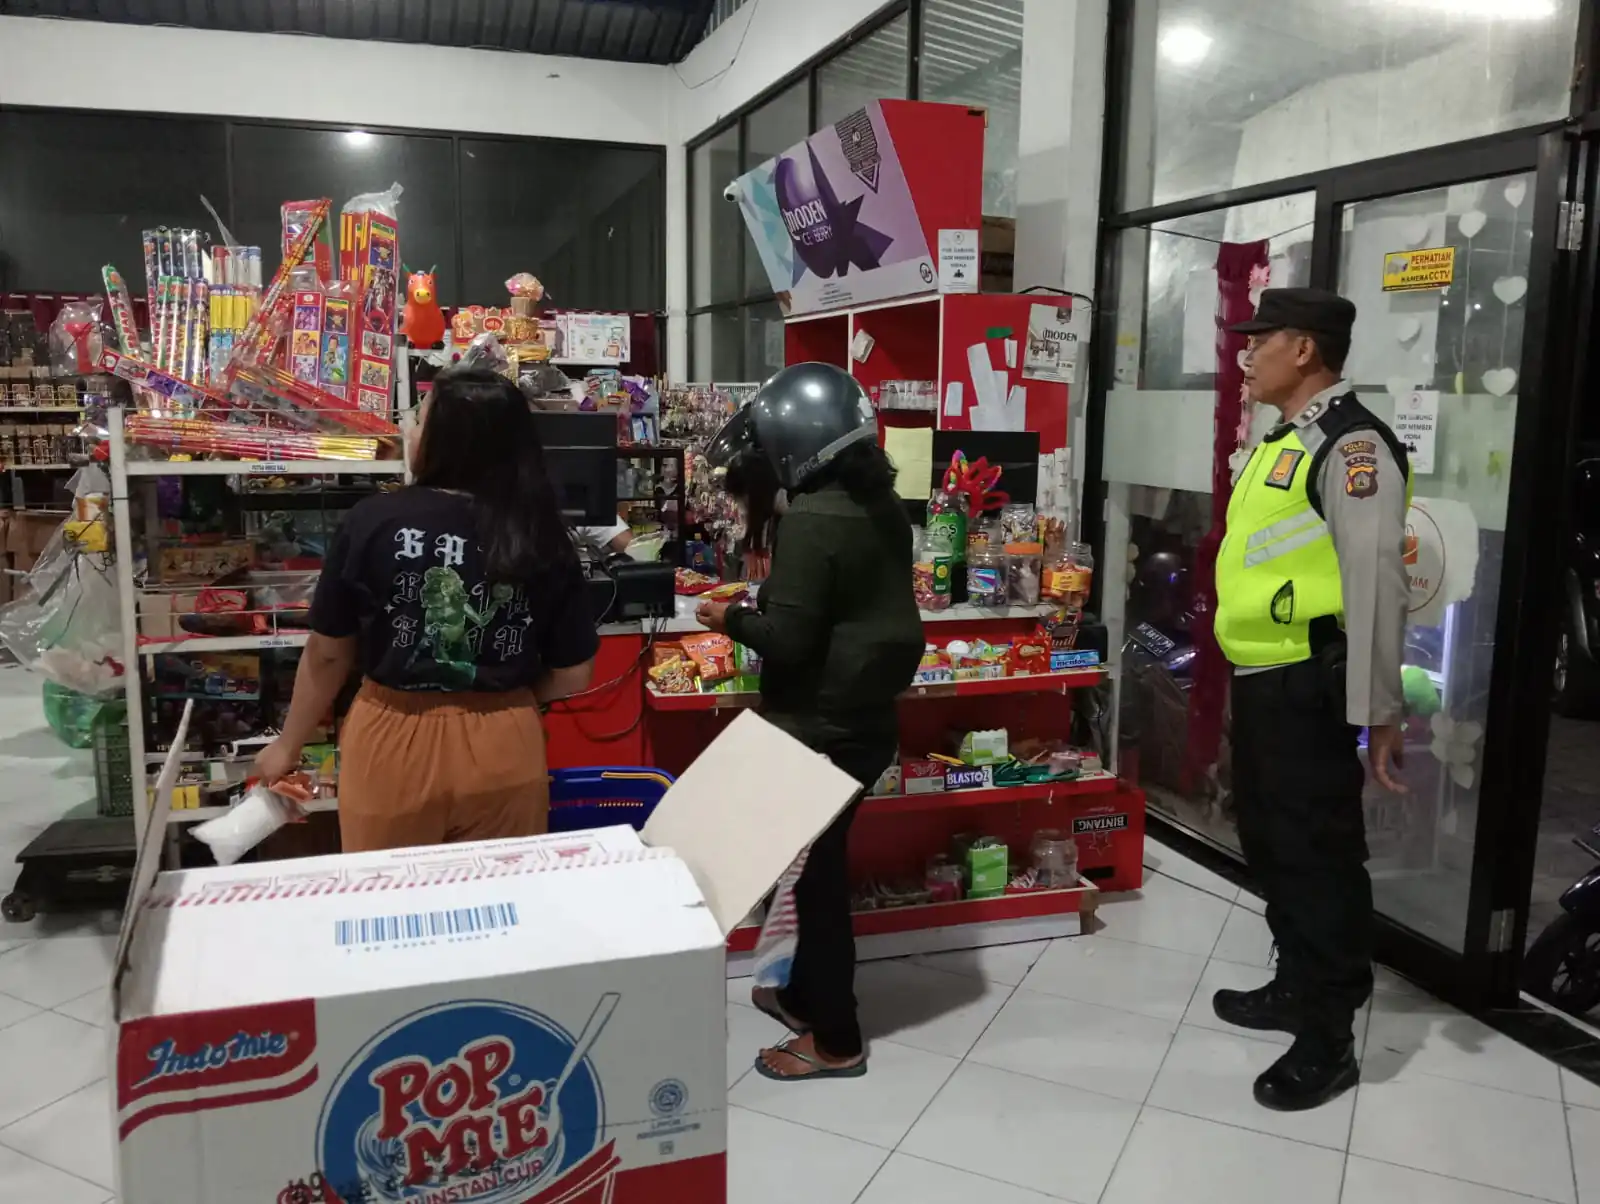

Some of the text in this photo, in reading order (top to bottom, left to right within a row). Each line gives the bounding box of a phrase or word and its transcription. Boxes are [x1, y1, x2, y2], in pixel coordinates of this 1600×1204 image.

[1428, 270, 1451, 280] CCTV
[1043, 327, 1078, 342] MODEN
[1056, 656, 1086, 668] mentos
[946, 769, 990, 784] BLASTOZ
[1079, 816, 1125, 830] BINTANG
[371, 1038, 513, 1142] POP
[403, 1086, 549, 1187] MIE
[505, 1160, 543, 1184] CUP
